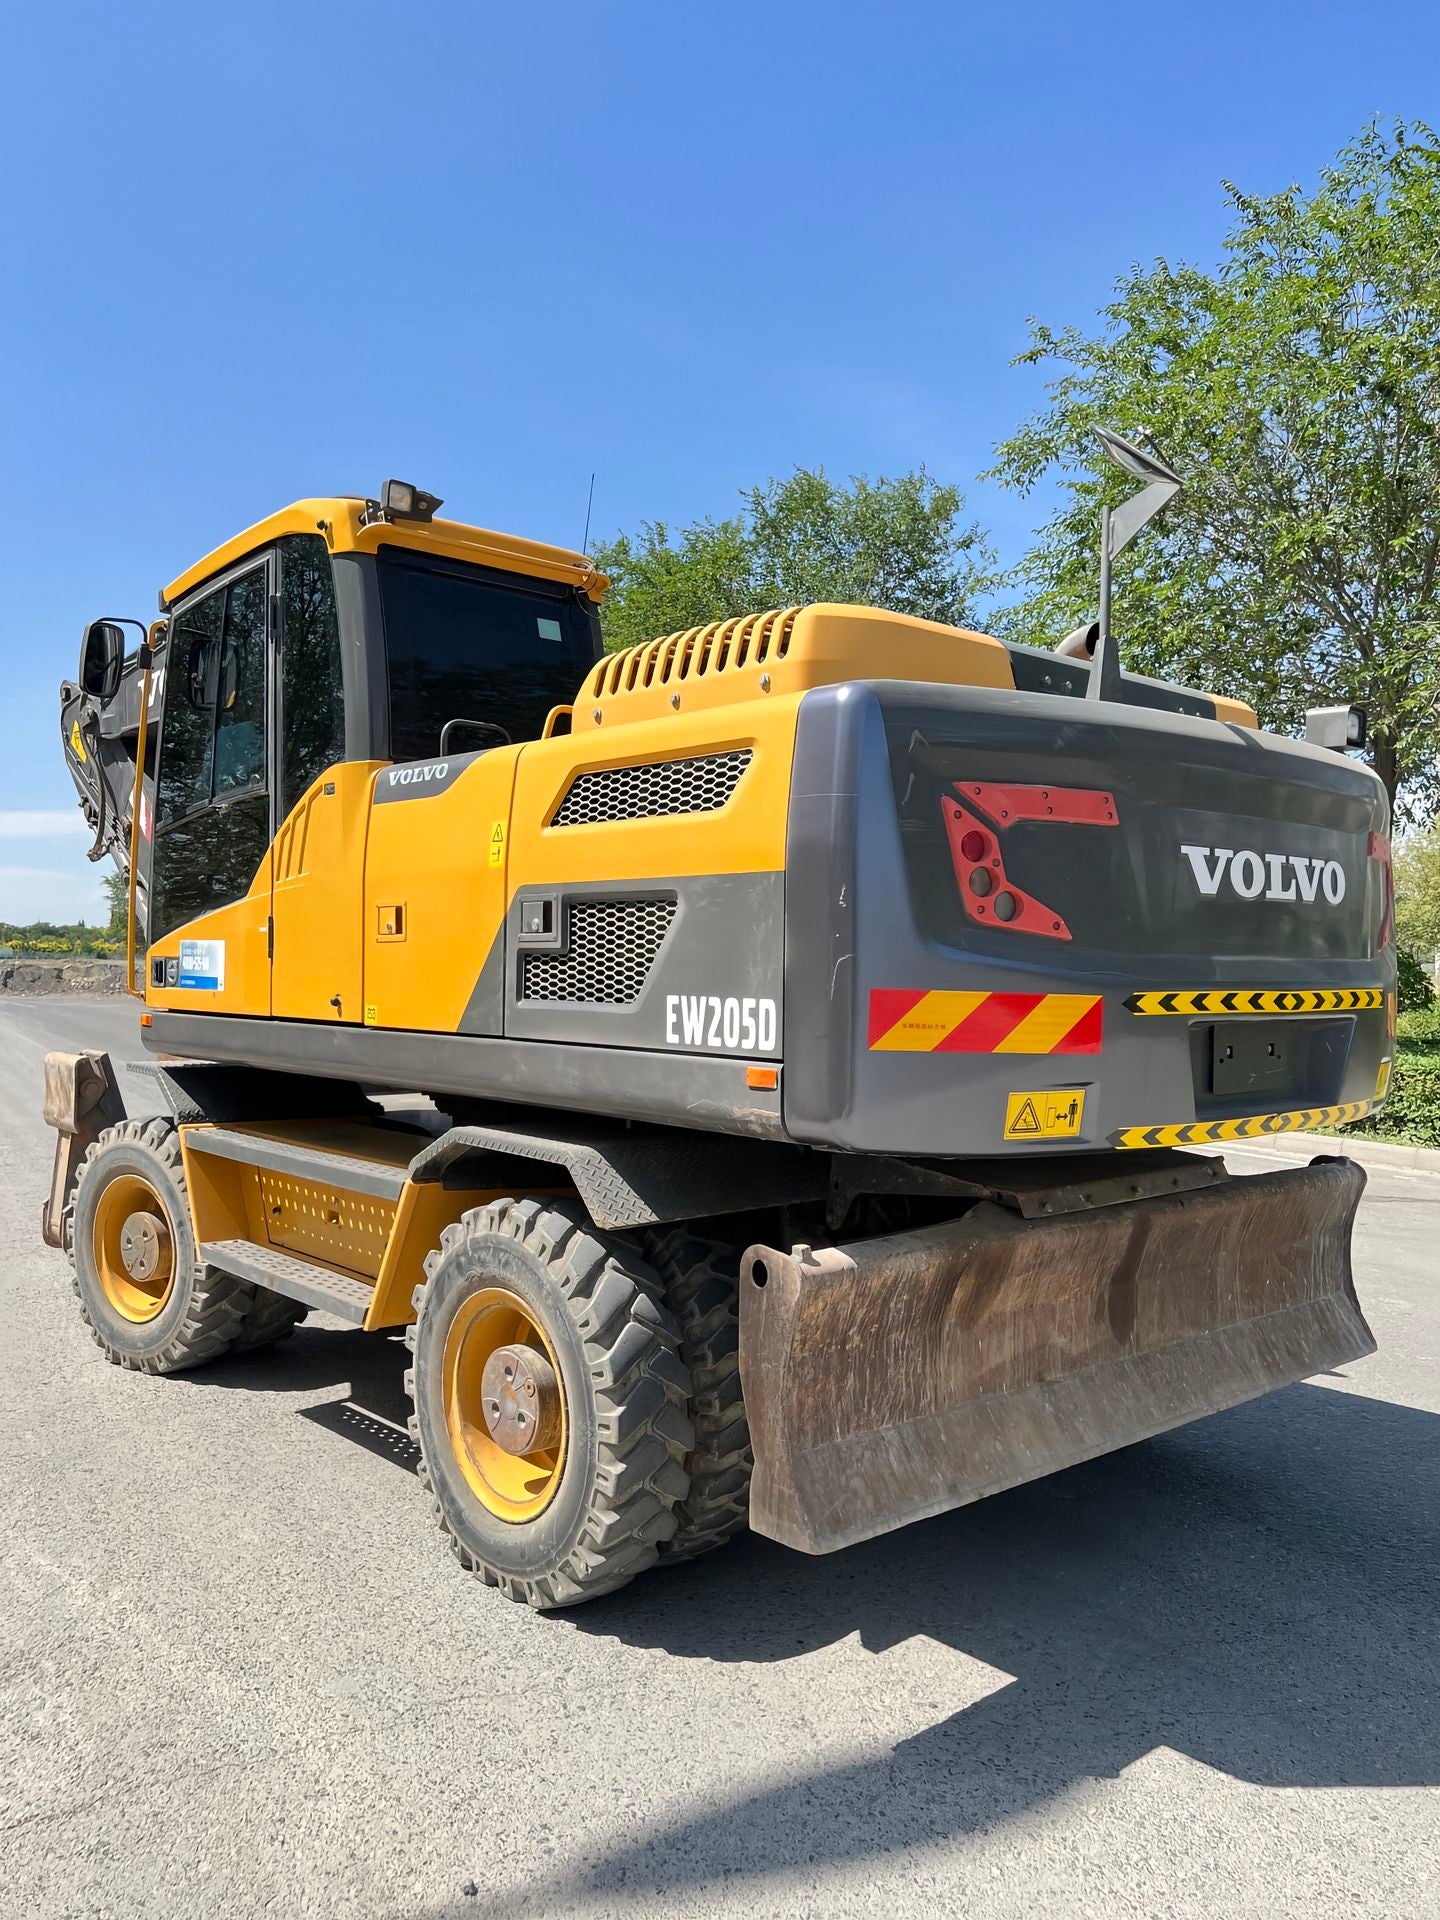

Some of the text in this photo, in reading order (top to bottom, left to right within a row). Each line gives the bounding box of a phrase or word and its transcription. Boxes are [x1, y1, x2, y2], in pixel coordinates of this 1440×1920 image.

[388, 763, 449, 786] VOLVO
[1181, 845, 1346, 905] VOLVO
[666, 995, 777, 1051] EW205D
